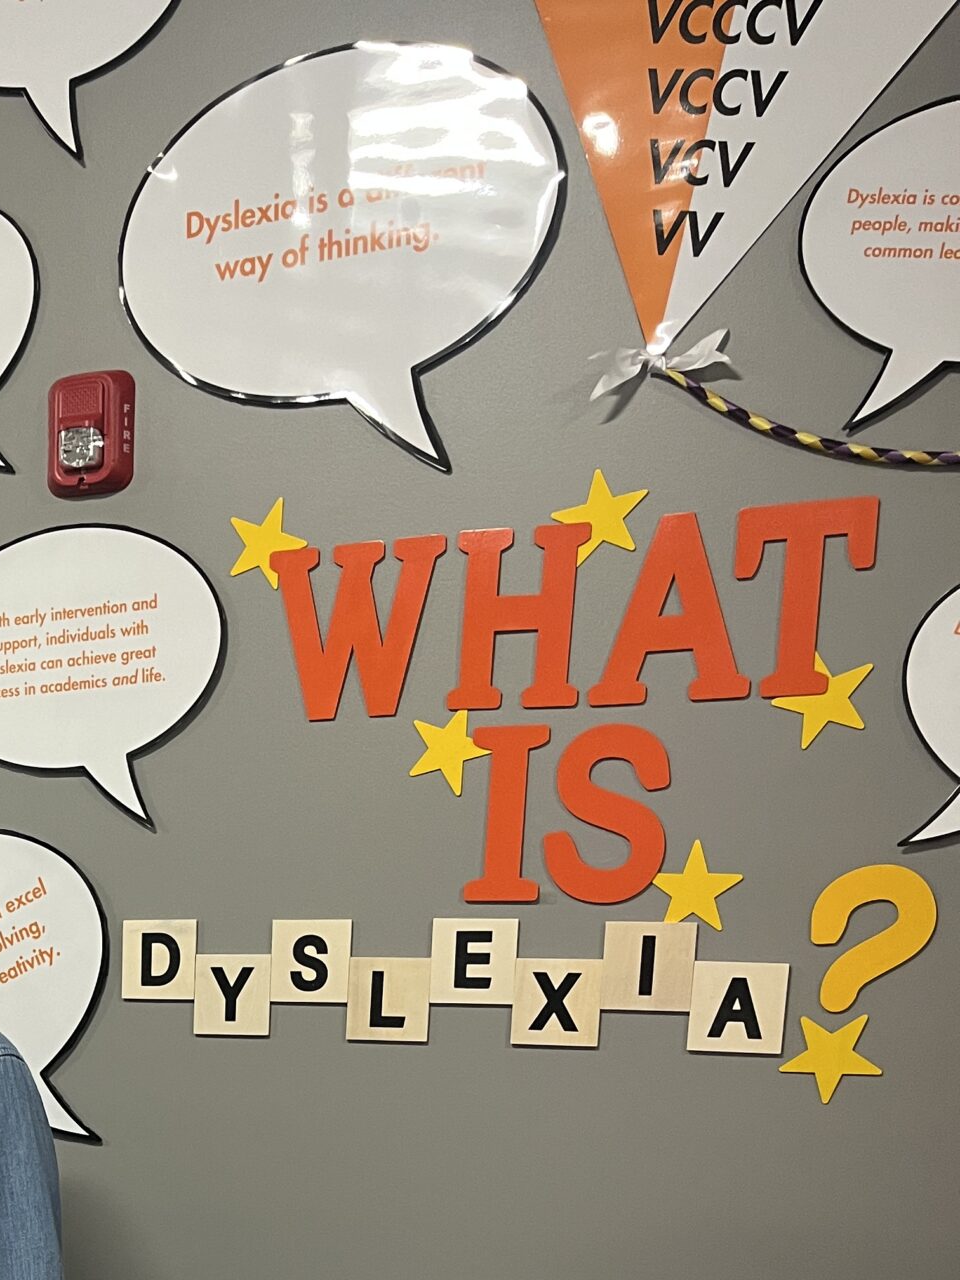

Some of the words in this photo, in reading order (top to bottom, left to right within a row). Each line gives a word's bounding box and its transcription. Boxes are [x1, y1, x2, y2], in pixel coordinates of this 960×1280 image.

[647, 0, 823, 46] VCCCV
[648, 68, 789, 118] VCCV
[650, 138, 756, 188] VCV
[186, 193, 297, 244] Dyslexia
[309, 186, 328, 214] is
[338, 188, 355, 209] a
[847, 187, 917, 208] Dyslexia
[922, 188, 936, 205] is
[653, 209, 724, 257] VV
[850, 214, 912, 236] people,
[215, 251, 273, 283] way
[282, 233, 309, 268] of
[318, 221, 439, 262] thinking.
[864, 246, 933, 259] common
[123, 403, 131, 454] FIRE
[14, 608, 46, 627] early
[51, 599, 127, 622] intervention
[132, 593, 158, 611] and
[268, 495, 881, 723] WHAT
[46, 623, 116, 647] individuals
[120, 619, 149, 636] with
[24, 682, 36, 696] in
[40, 675, 107, 694] academics
[112, 669, 139, 687] and
[141, 667, 166, 684] life.
[40, 658, 63, 671] can
[67, 650, 117, 668] achieve
[121, 645, 157, 665] great
[463, 722, 672, 905] IS
[5, 876, 47, 914] excel
[140, 929, 764, 1041] DYSLEXIA
